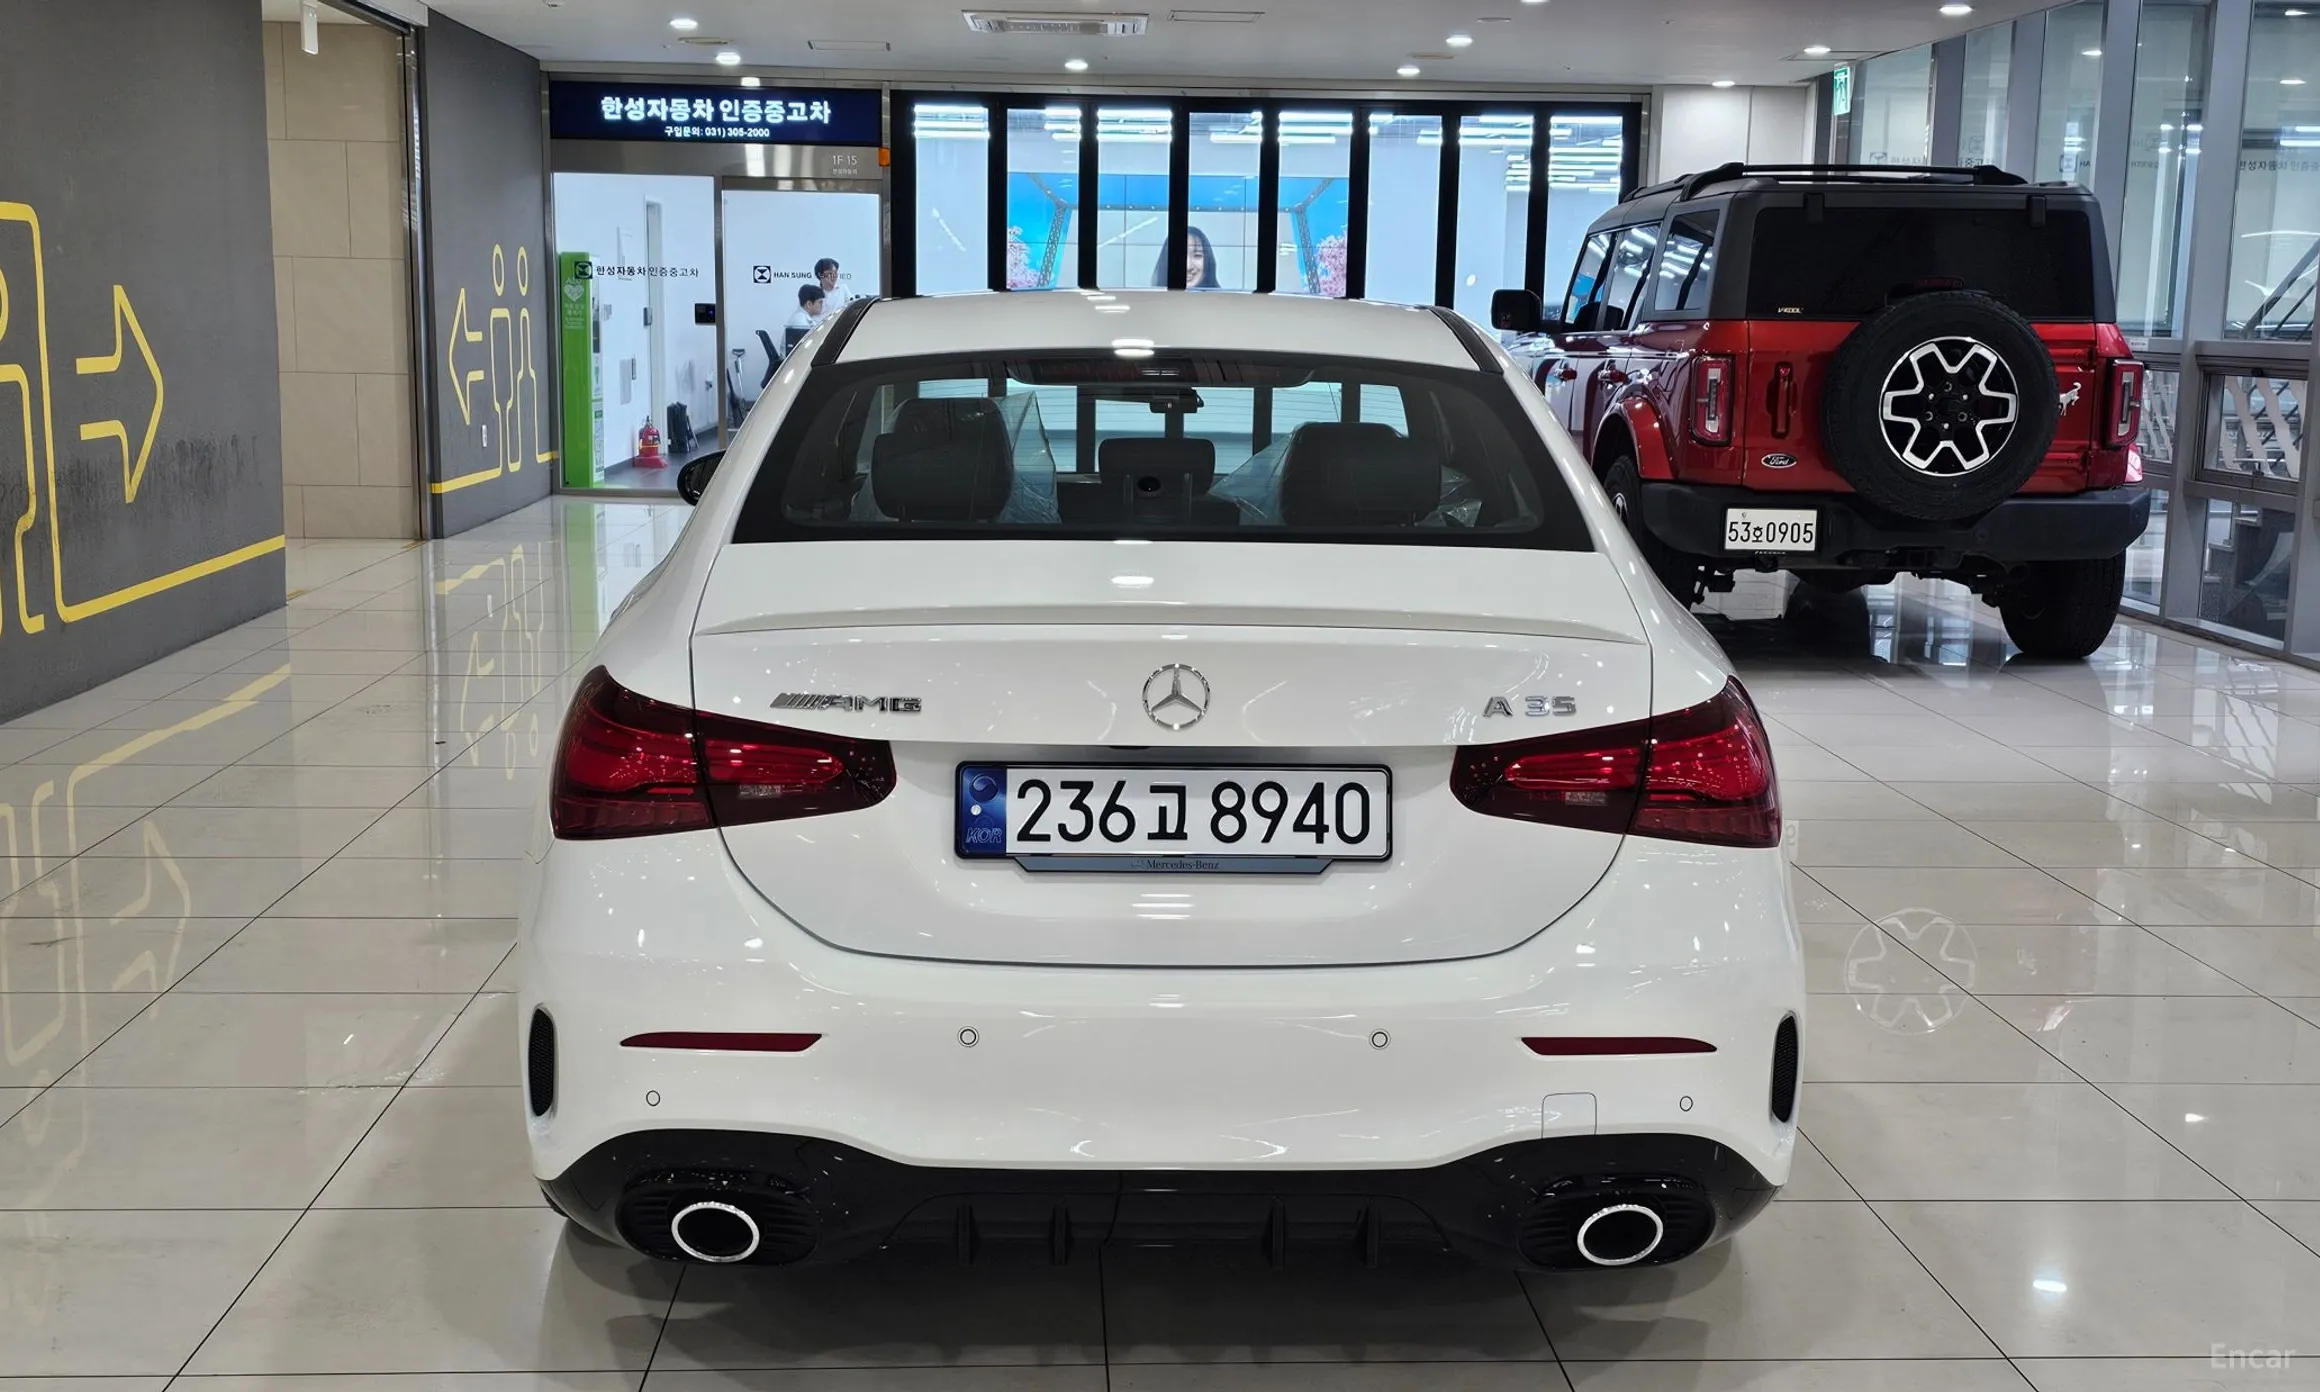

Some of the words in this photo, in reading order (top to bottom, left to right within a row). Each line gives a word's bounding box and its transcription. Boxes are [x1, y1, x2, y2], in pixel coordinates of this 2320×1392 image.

[601, 96, 715, 122] 한성자동차
[718, 99, 832, 124] 인증중고차
[664, 126, 704, 138] 구입문의:
[704, 126, 727, 139] 031)
[727, 127, 770, 138] 305-2000
[832, 154, 843, 165] 1F
[847, 154, 858, 166] 15
[596, 265, 647, 277] 한성자동차
[648, 266, 699, 278] 인증중고차
[791, 272, 813, 280] SUNG
[1769, 456, 1790, 466] Ford
[1727, 521, 1814, 544] 53호0905
[817, 694, 922, 712] AMG
[1482, 696, 1514, 718] A
[1524, 695, 1577, 717] 35
[1016, 778, 1188, 844] 236고
[1209, 780, 1371, 845] 8940
[965, 827, 1002, 844] KOR
[1146, 859, 1220, 871] Mercedes-Benz
